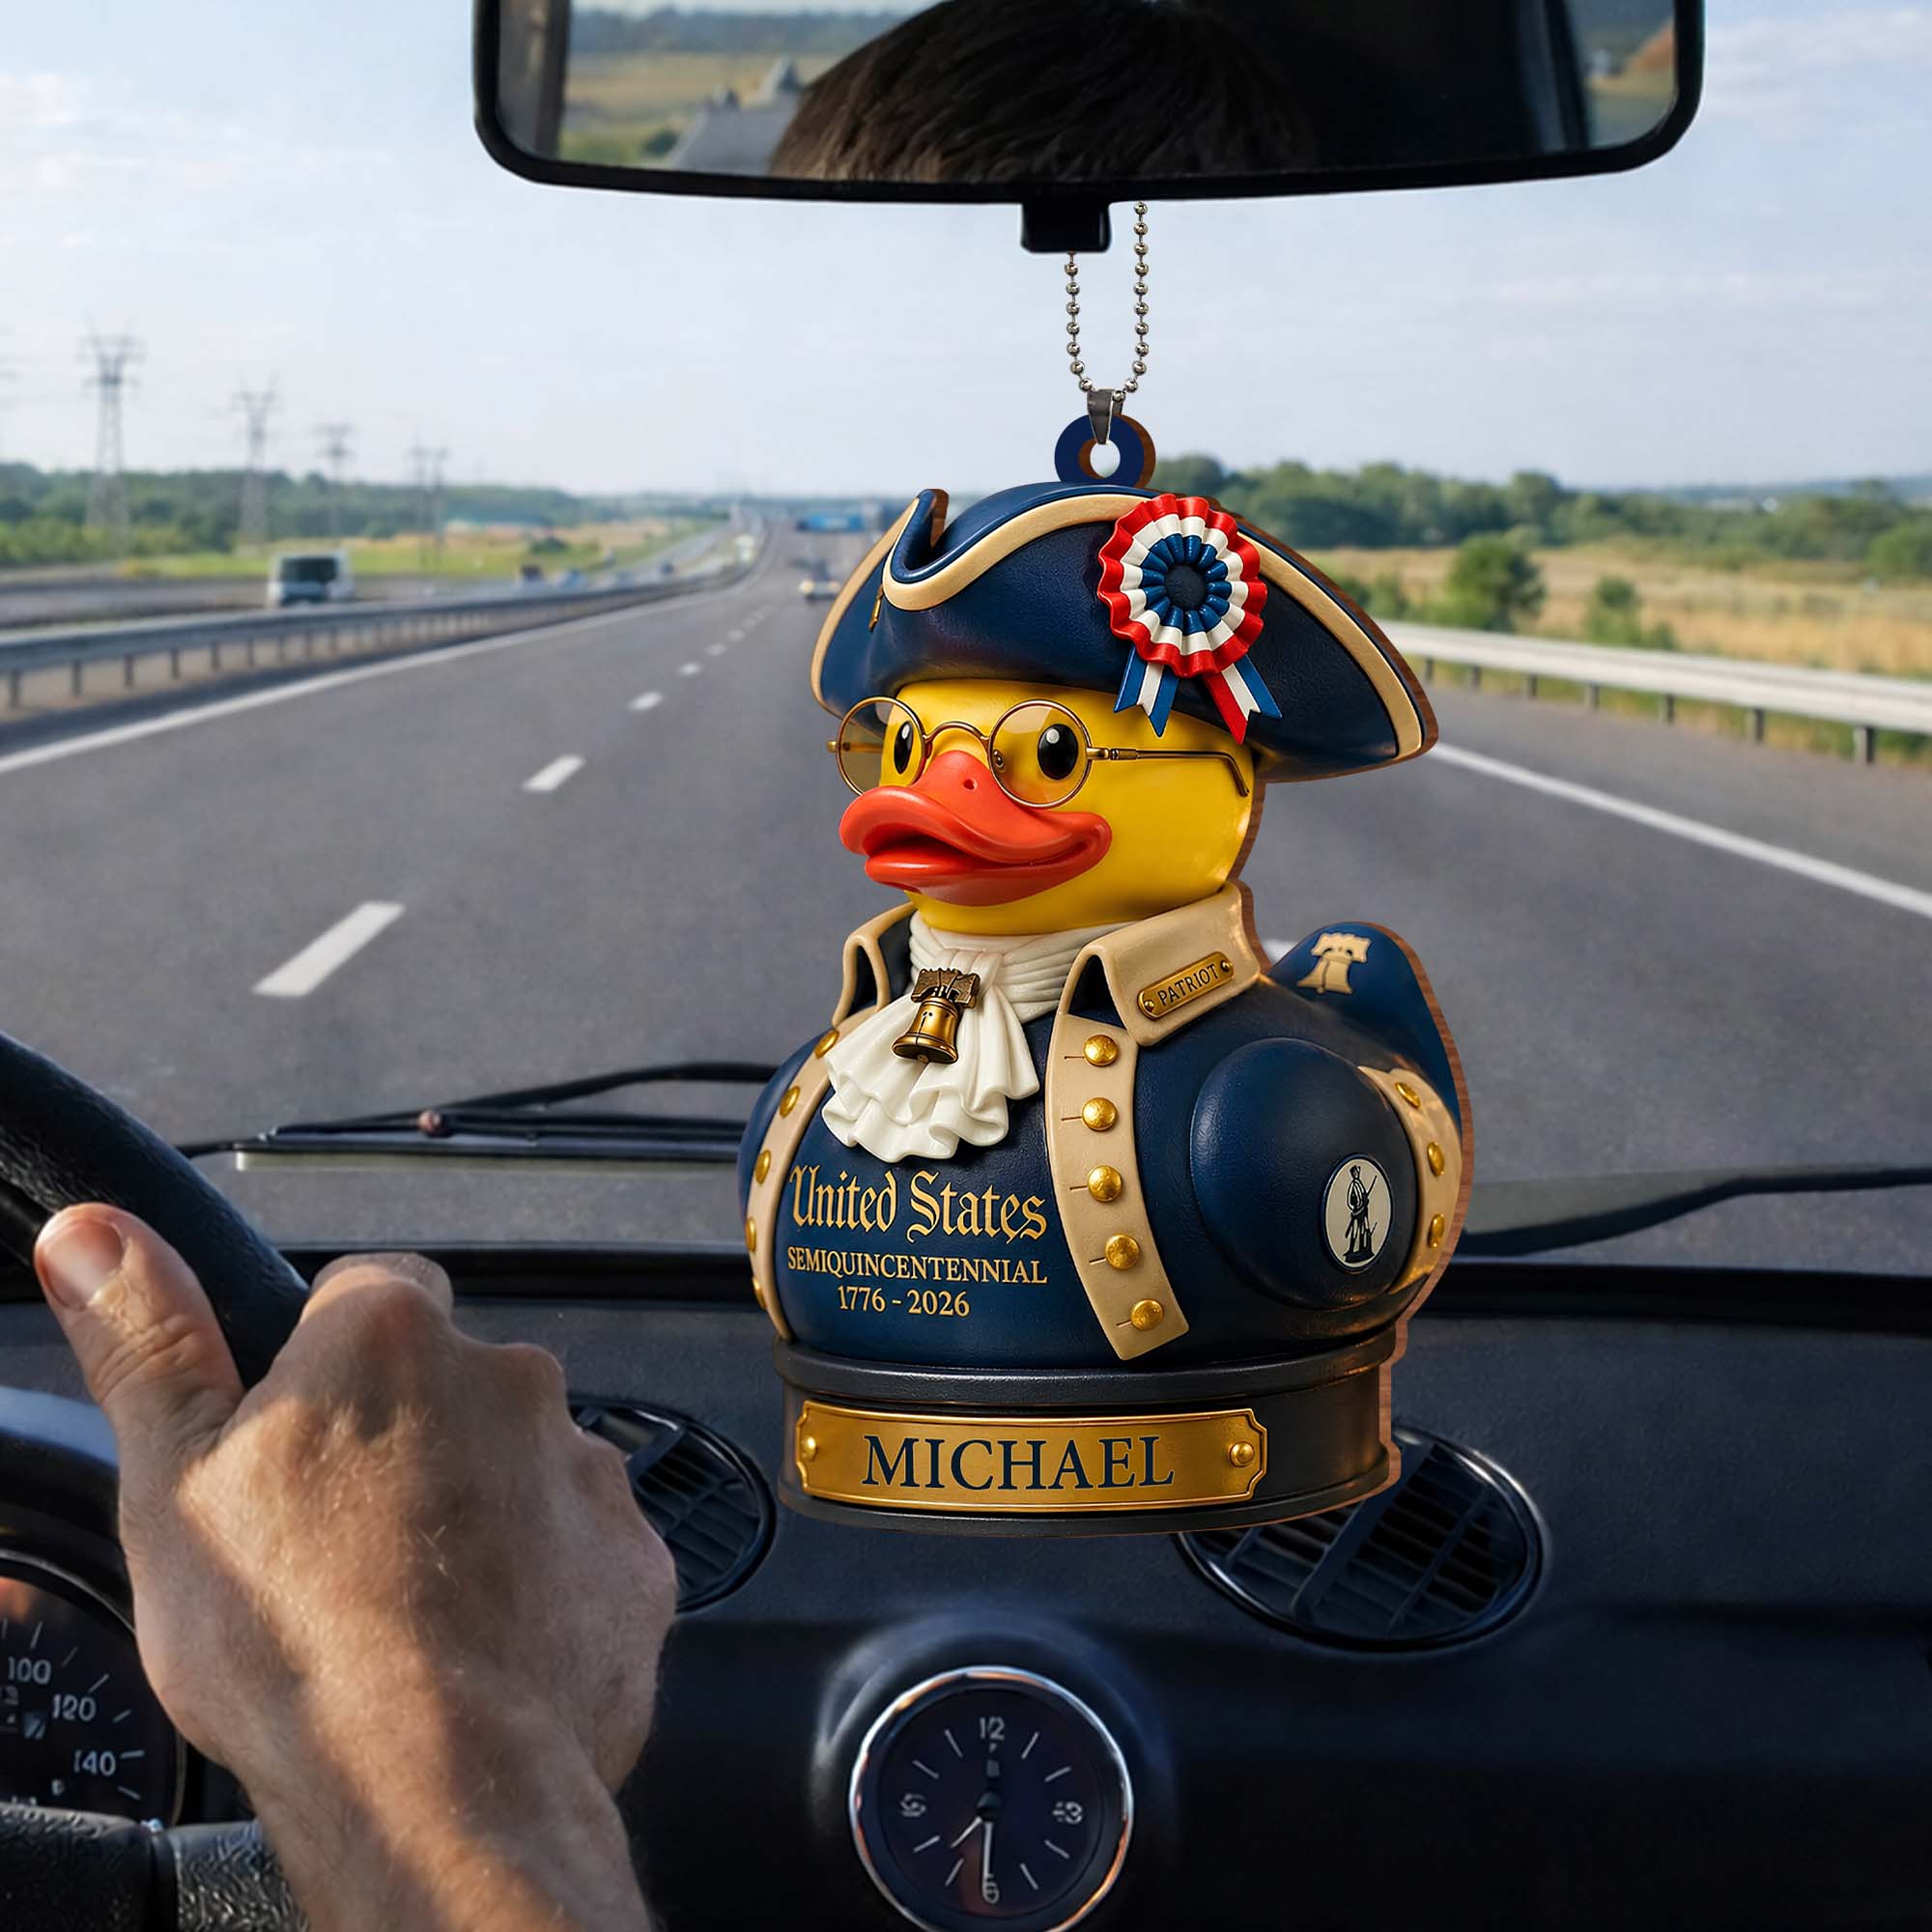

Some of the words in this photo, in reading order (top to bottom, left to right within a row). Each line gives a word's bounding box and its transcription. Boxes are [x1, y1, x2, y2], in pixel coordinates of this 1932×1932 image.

[1157, 964, 1219, 1007] PATRIOT
[789, 1164, 897, 1233] United
[906, 1170, 1047, 1244] States
[787, 1246, 1048, 1284] SEMIQUINCENTENNIAL
[837, 1286, 887, 1313] 1776
[906, 1289, 971, 1318] 2026
[862, 1435, 1176, 1491] MICHAEL
[8, 1657, 52, 1685] 100
[52, 1693, 97, 1721] 120
[979, 1716, 1006, 1741] 12
[73, 1749, 117, 1776] 140
